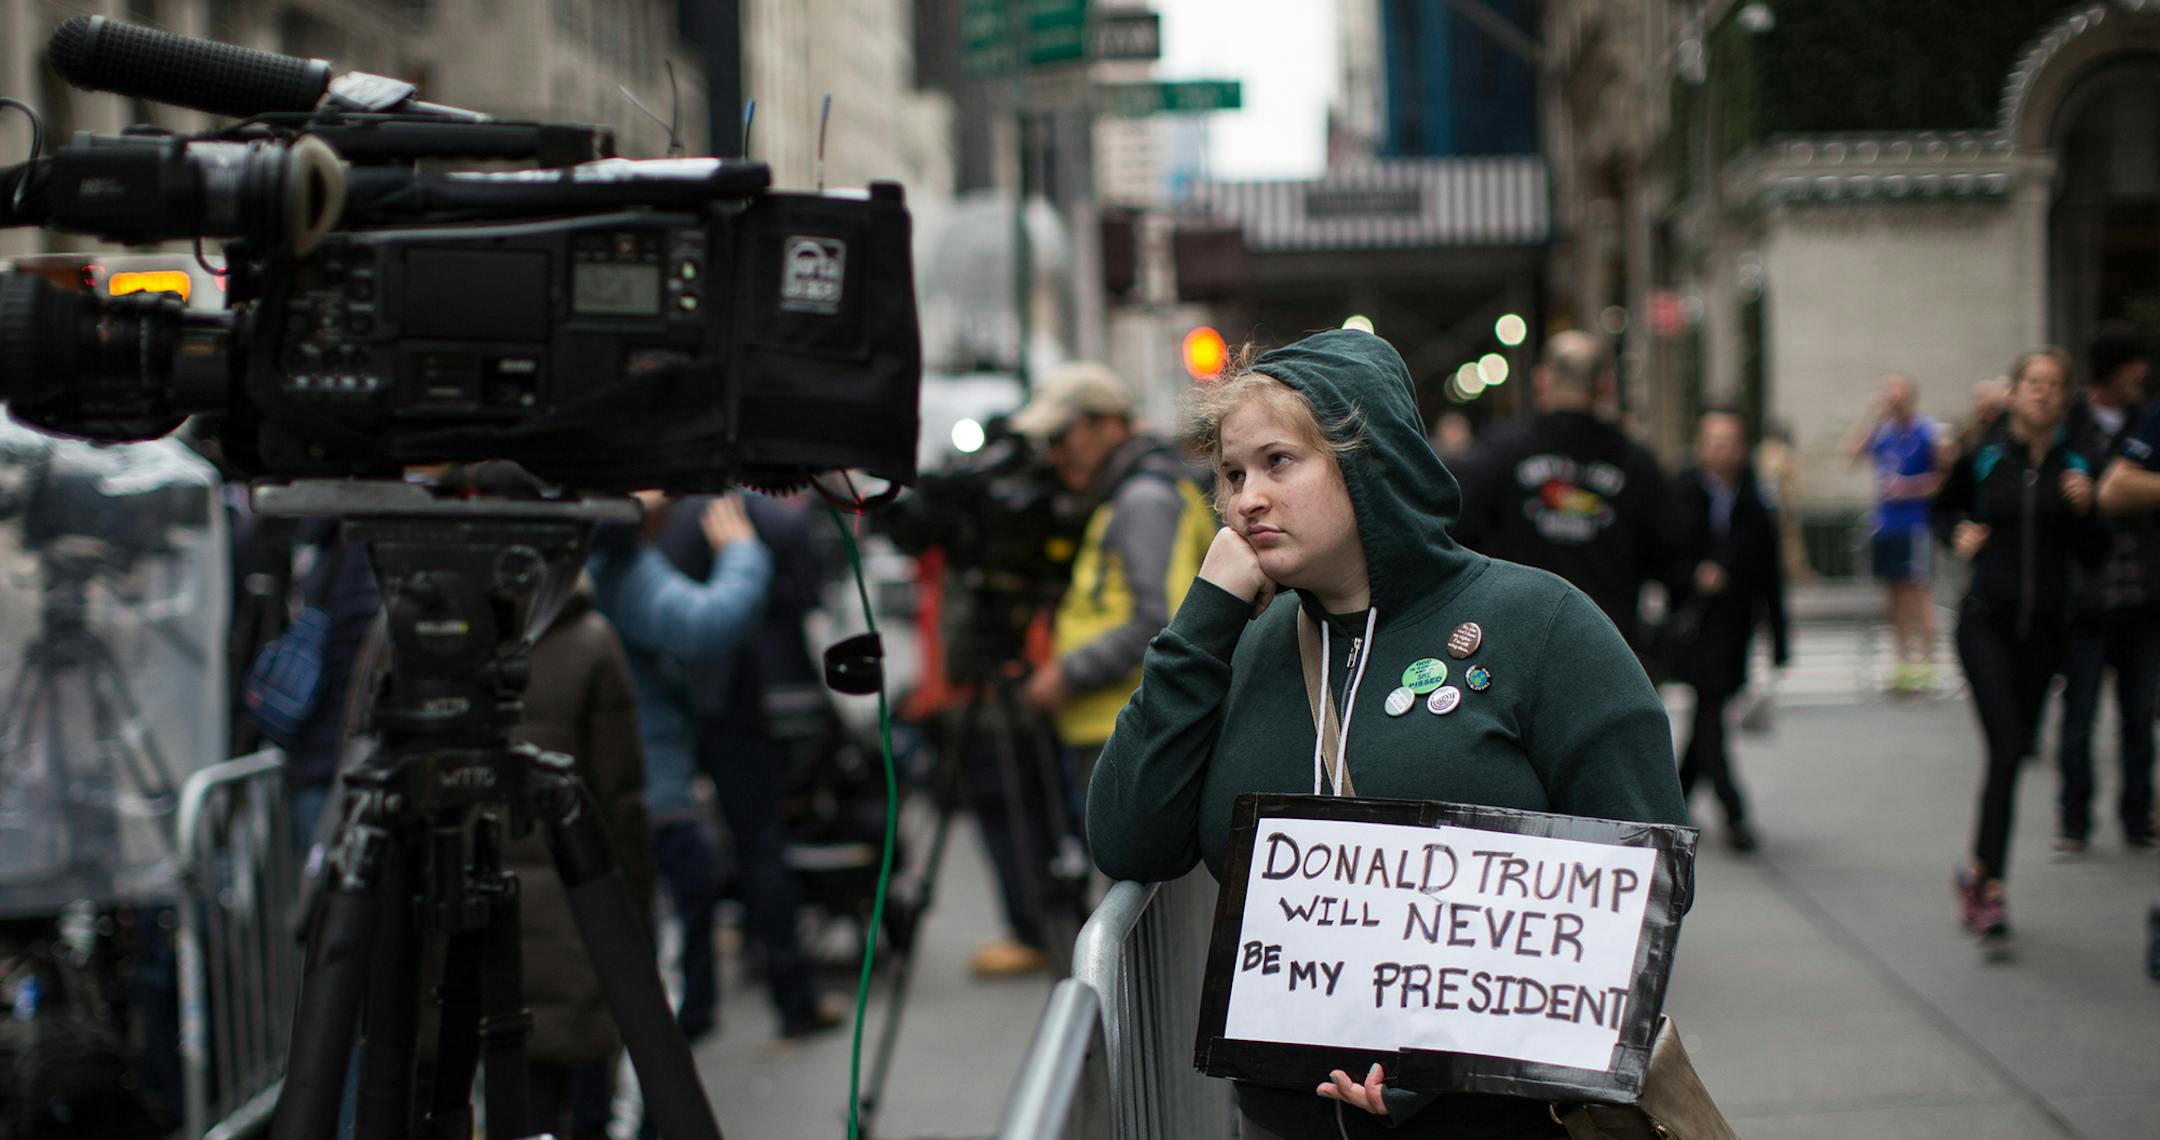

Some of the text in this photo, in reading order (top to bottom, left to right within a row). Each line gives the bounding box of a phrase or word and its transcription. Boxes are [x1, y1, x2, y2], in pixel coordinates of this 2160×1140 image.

[1262, 832, 1638, 912] DONALD TRUMP
[1279, 895, 1584, 962] WILL NEVER
[1242, 941, 1628, 1030] BE MY PRESIDENT
